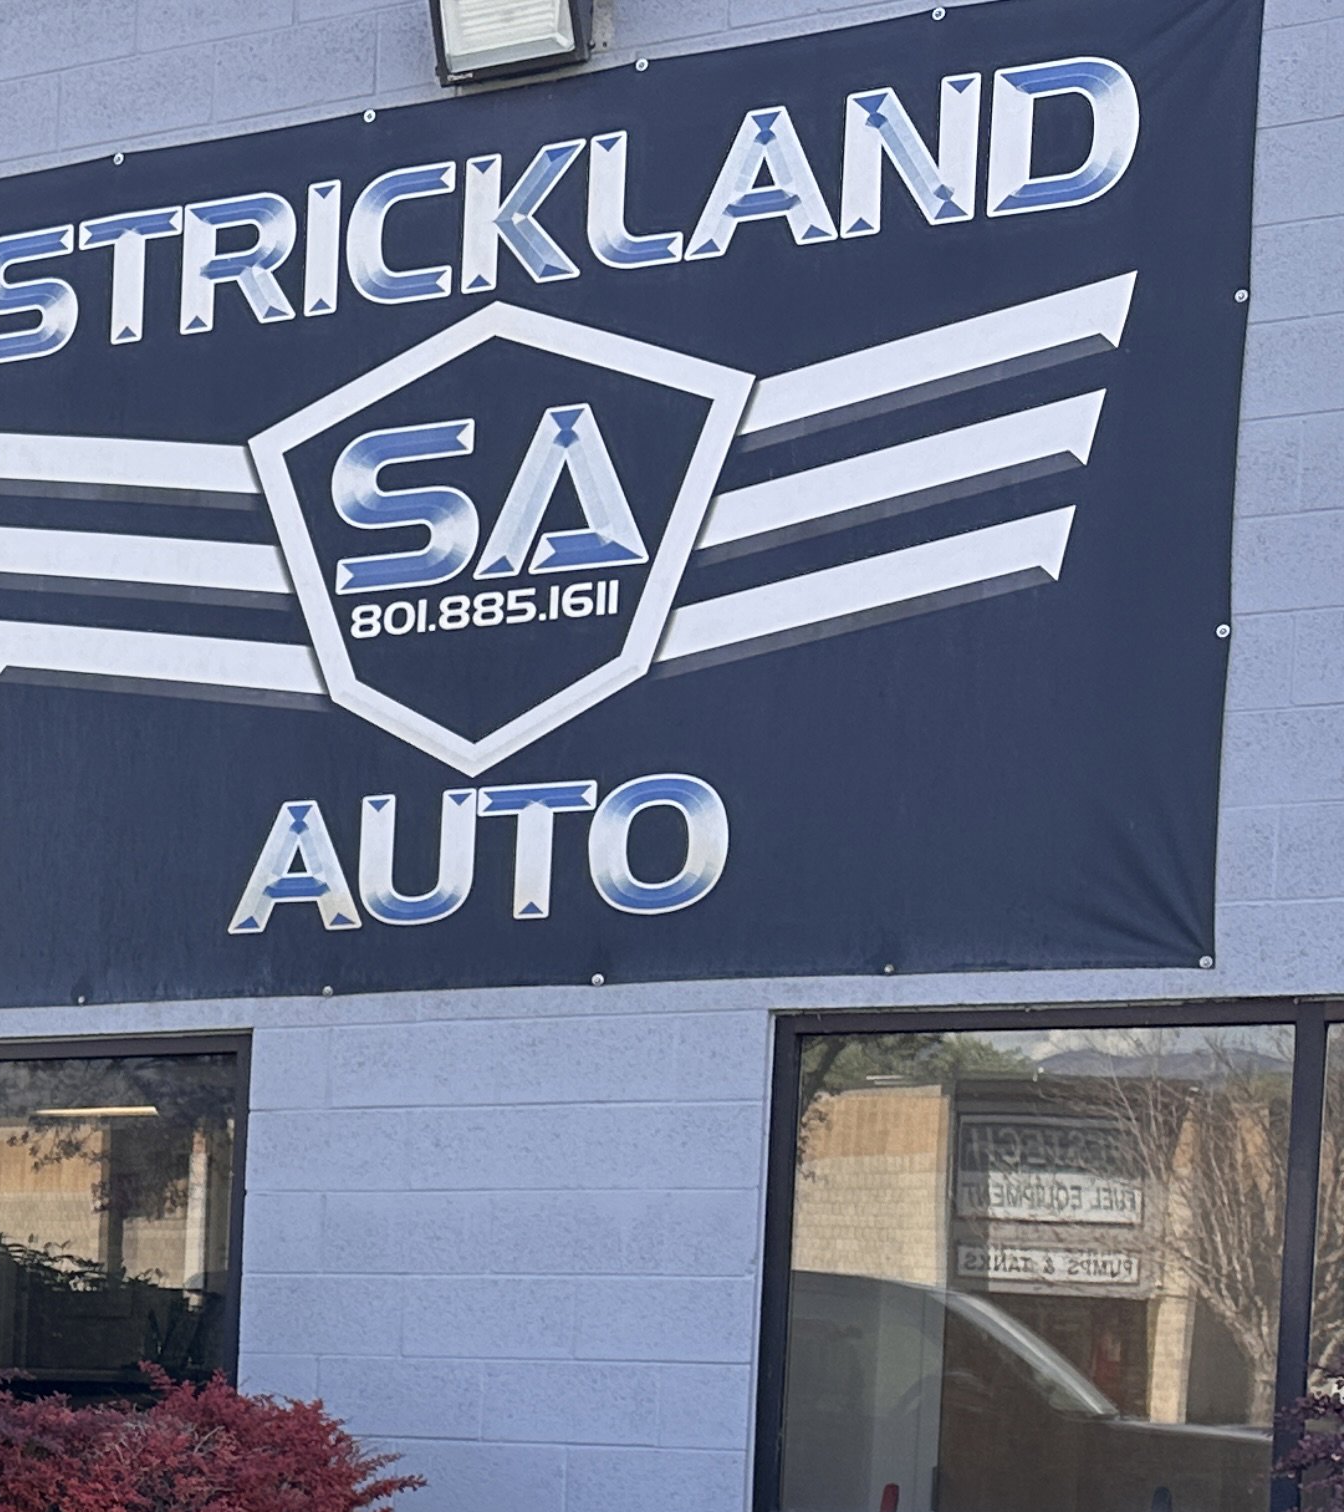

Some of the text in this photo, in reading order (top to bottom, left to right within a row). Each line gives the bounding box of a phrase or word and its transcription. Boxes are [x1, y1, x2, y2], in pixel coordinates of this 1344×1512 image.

[329, 402, 649, 596] SA
[349, 578, 620, 640] 801.885.1611
[226, 771, 731, 935] AUTO
